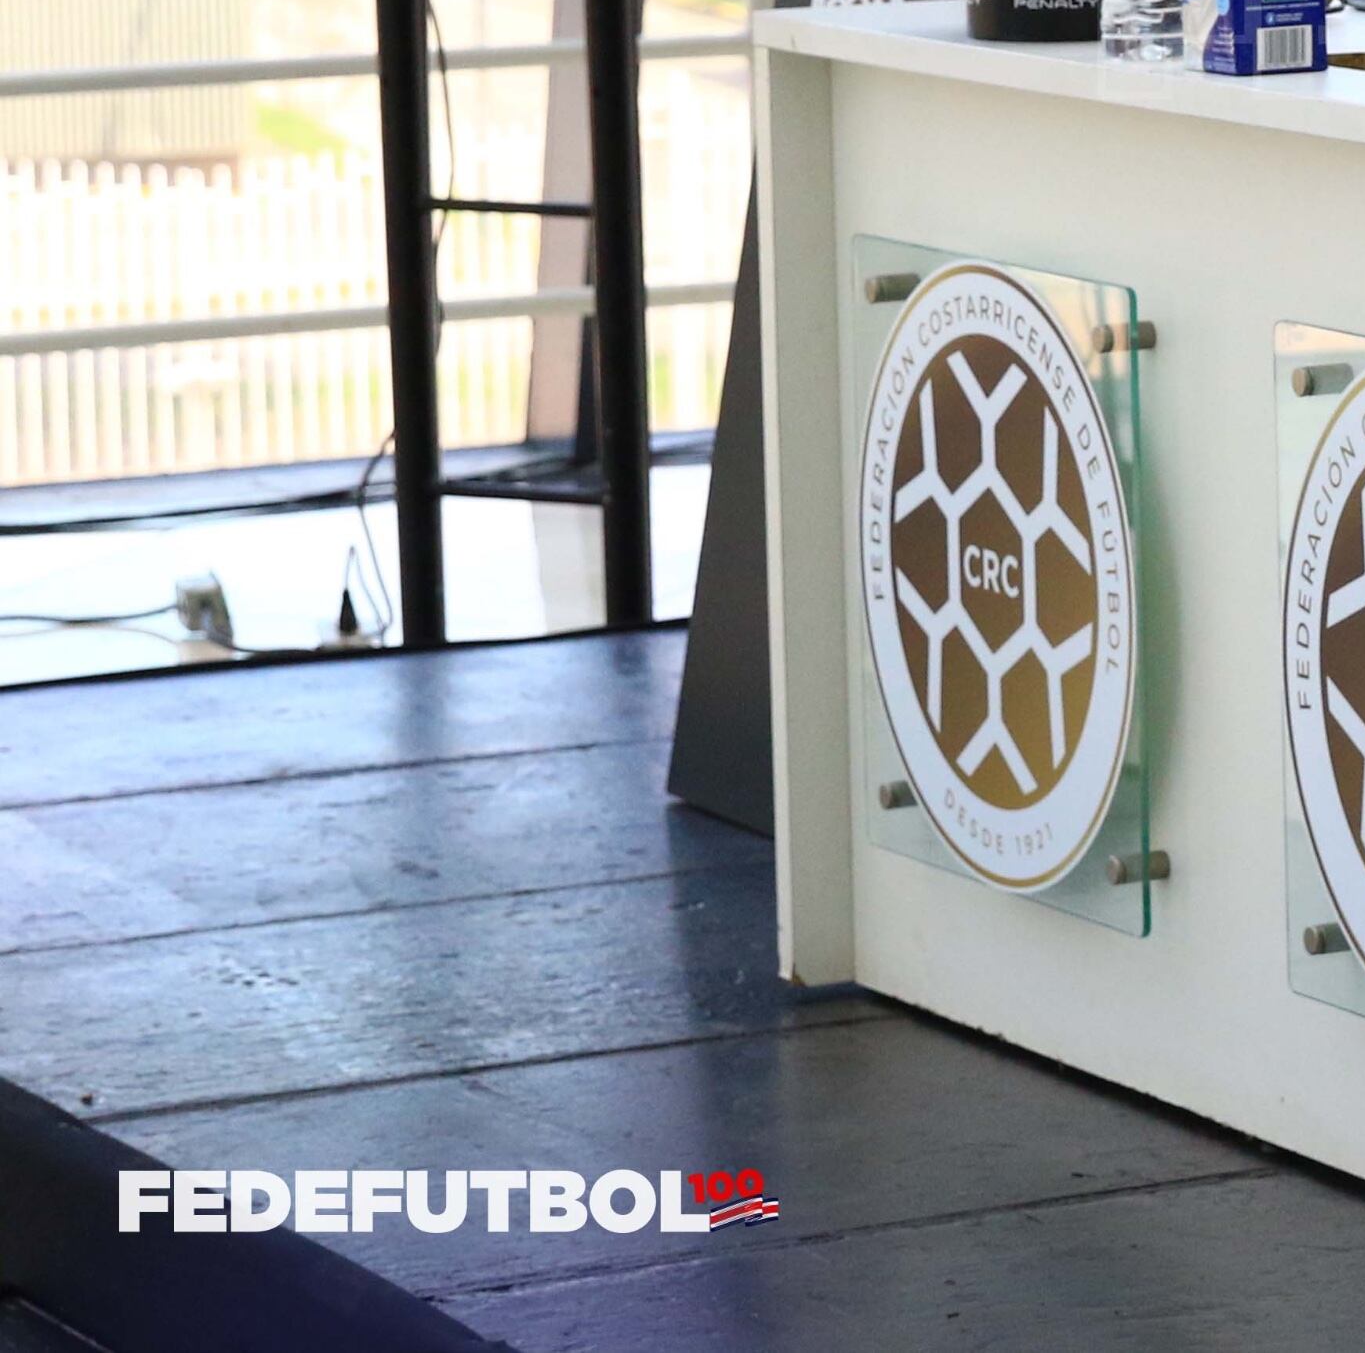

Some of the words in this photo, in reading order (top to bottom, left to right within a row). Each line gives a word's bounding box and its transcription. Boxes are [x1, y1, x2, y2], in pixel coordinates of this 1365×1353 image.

[871, 348, 917, 601] FEDERACIÓN
[918, 295, 1076, 412] COSTARRICENSE
[1076, 423, 1101, 481] DE
[1096, 500, 1119, 676] FÚTBOL
[963, 544, 1020, 598] CRC
[1296, 442, 1355, 710] FEDERACIÓN
[943, 787, 1005, 856] DESDE
[1015, 823, 1054, 857] 1921
